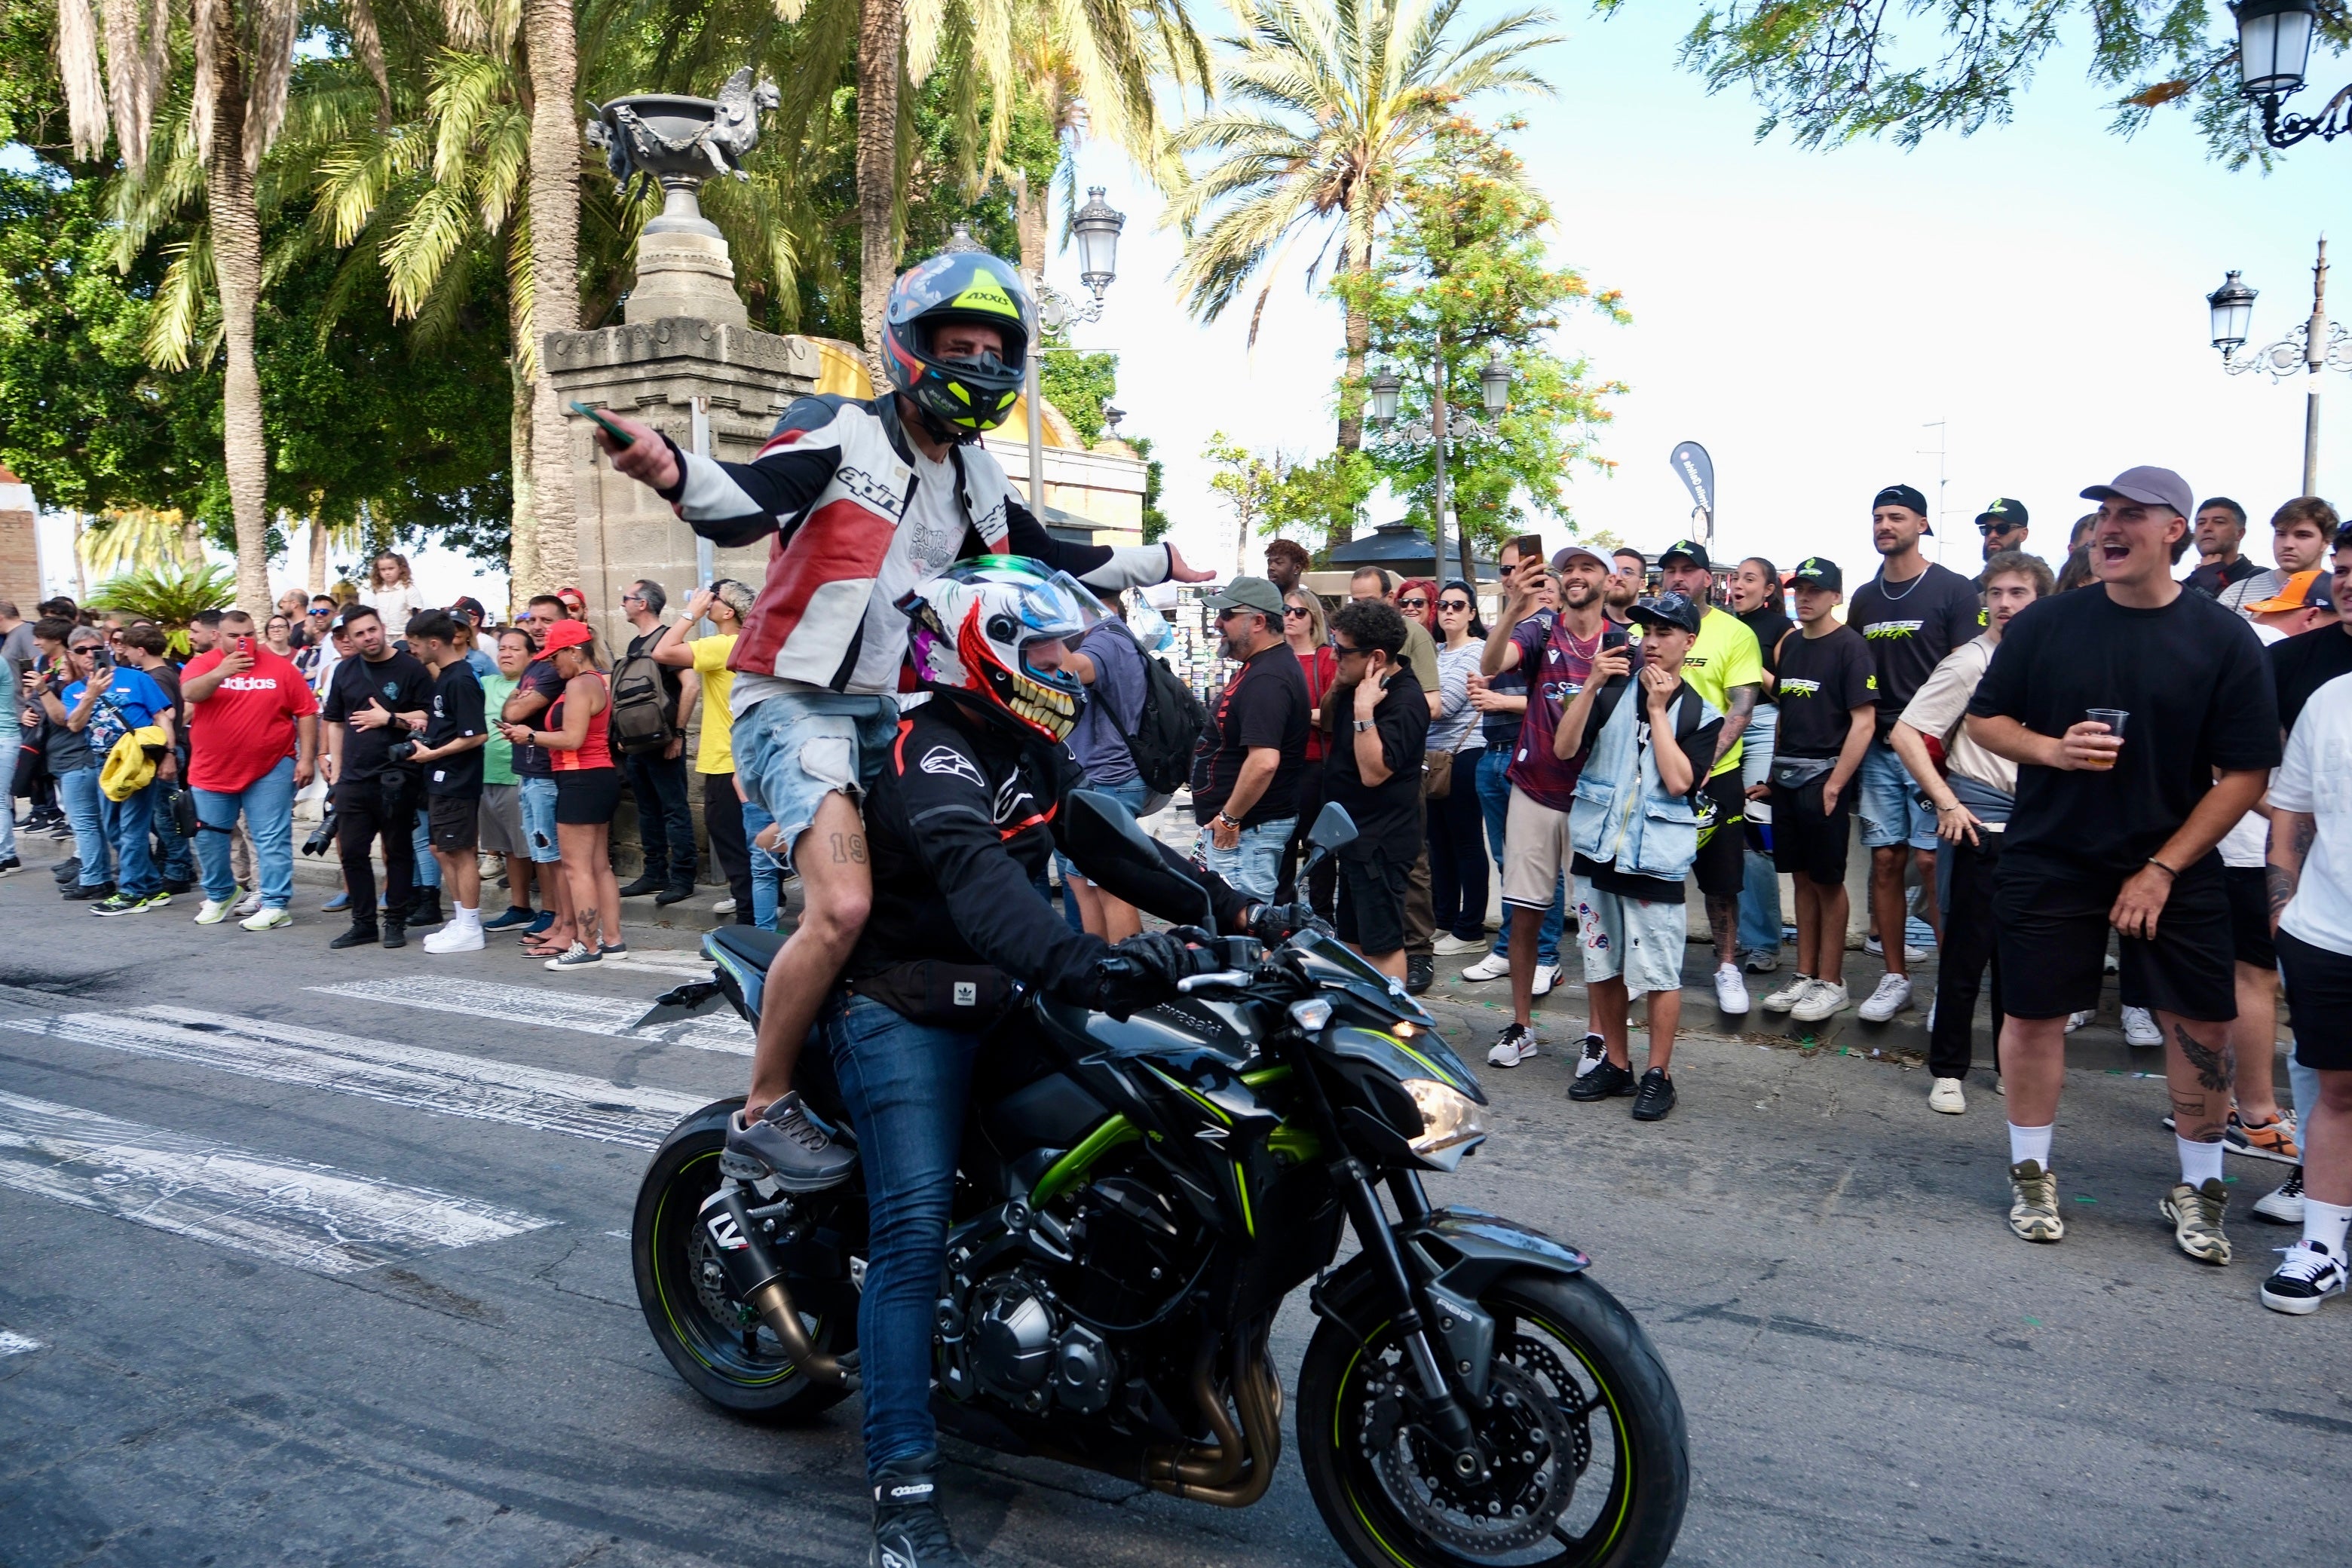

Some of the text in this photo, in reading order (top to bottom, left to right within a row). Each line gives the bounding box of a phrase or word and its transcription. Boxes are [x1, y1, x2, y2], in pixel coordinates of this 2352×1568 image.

[966, 292, 1009, 305] AXXIS
[830, 833, 866, 864] 19
[707, 1211, 748, 1248] LV
[1436, 1297, 1473, 1322] ABS
